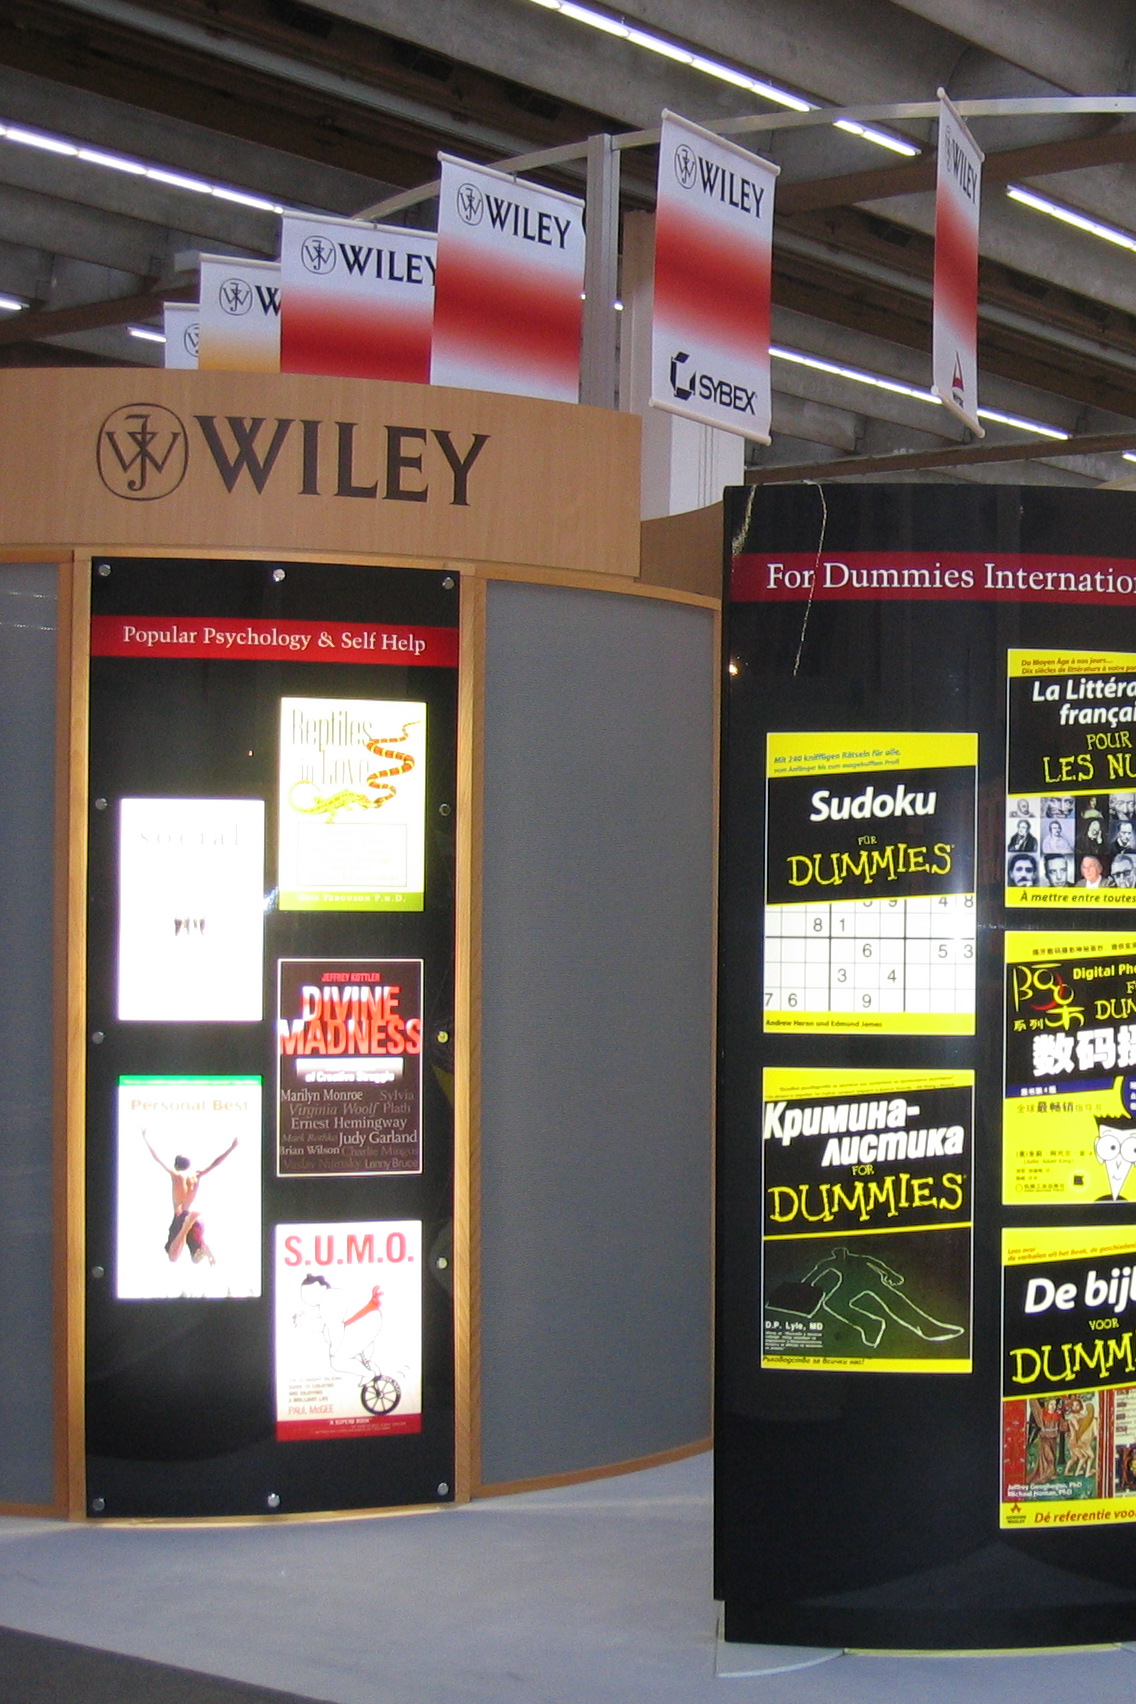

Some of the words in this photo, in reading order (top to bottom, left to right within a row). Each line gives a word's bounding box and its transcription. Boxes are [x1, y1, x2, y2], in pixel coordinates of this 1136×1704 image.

[952, 137, 978, 205] WILEY
[697, 156, 765, 219] WILEY
[484, 193, 571, 250] WILEY
[699, 373, 757, 415] SYBEX
[193, 413, 491, 507] WILEY
[767, 562, 815, 589] For
[823, 562, 975, 589] Dummies
[123, 625, 197, 648] Popular
[202, 627, 311, 651] Psychology
[317, 631, 336, 648] &
[341, 630, 376, 649] Self
[381, 633, 426, 656] Help
[1032, 680, 1060, 702] La
[292, 708, 373, 752] Reptiles
[1086, 730, 1133, 750] POUR
[1042, 753, 1095, 784] LES
[809, 784, 938, 823] Sudoku
[857, 835, 878, 847] FÜR
[786, 842, 953, 887] DUMMIES
[1019, 889, 1029, 903] À
[1030, 892, 1069, 903] mettre
[1071, 893, 1101, 904] entre
[1103, 893, 1136, 904] toutes
[813, 917, 823, 931] 8
[839, 918, 846, 931] 1
[862, 943, 873, 958] 6
[938, 944, 949, 958] 5
[963, 944, 974, 958] 3
[321, 972, 350, 982] JEFFREY
[837, 968, 847, 983] 3
[887, 969, 897, 983] 4
[1072, 964, 1115, 982] Digital
[301, 985, 400, 1022] DIVINE
[764, 992, 774, 1006] 7
[787, 993, 798, 1007] 6
[862, 993, 872, 1008] 9
[280, 1018, 421, 1056] MADNESS
[130, 1099, 206, 1111] Personal
[212, 1099, 248, 1111] Best
[281, 1088, 320, 1105] Marilyn
[323, 1089, 364, 1102] Monroe
[380, 1088, 414, 1102] Sylvia
[289, 1102, 338, 1118] Virginia
[343, 1102, 380, 1117] Woolf
[383, 1102, 411, 1114] Plath
[291, 1117, 330, 1130] Ernest
[334, 1116, 408, 1131] Hemingway
[338, 1132, 367, 1147] Judy
[368, 1130, 418, 1144] Garland
[821, 1125, 965, 1167] листика
[306, 1145, 340, 1155] Wilson
[851, 1164, 875, 1176] FOR
[767, 1172, 964, 1223] DUMMIES
[283, 1231, 415, 1268] S.U.M.O.
[1024, 1277, 1077, 1314] De
[1089, 1317, 1120, 1331] VOOR
[288, 1404, 306, 1416] PAUL
[1034, 1512, 1051, 1524] Dé
[1053, 1510, 1111, 1523] referentie
